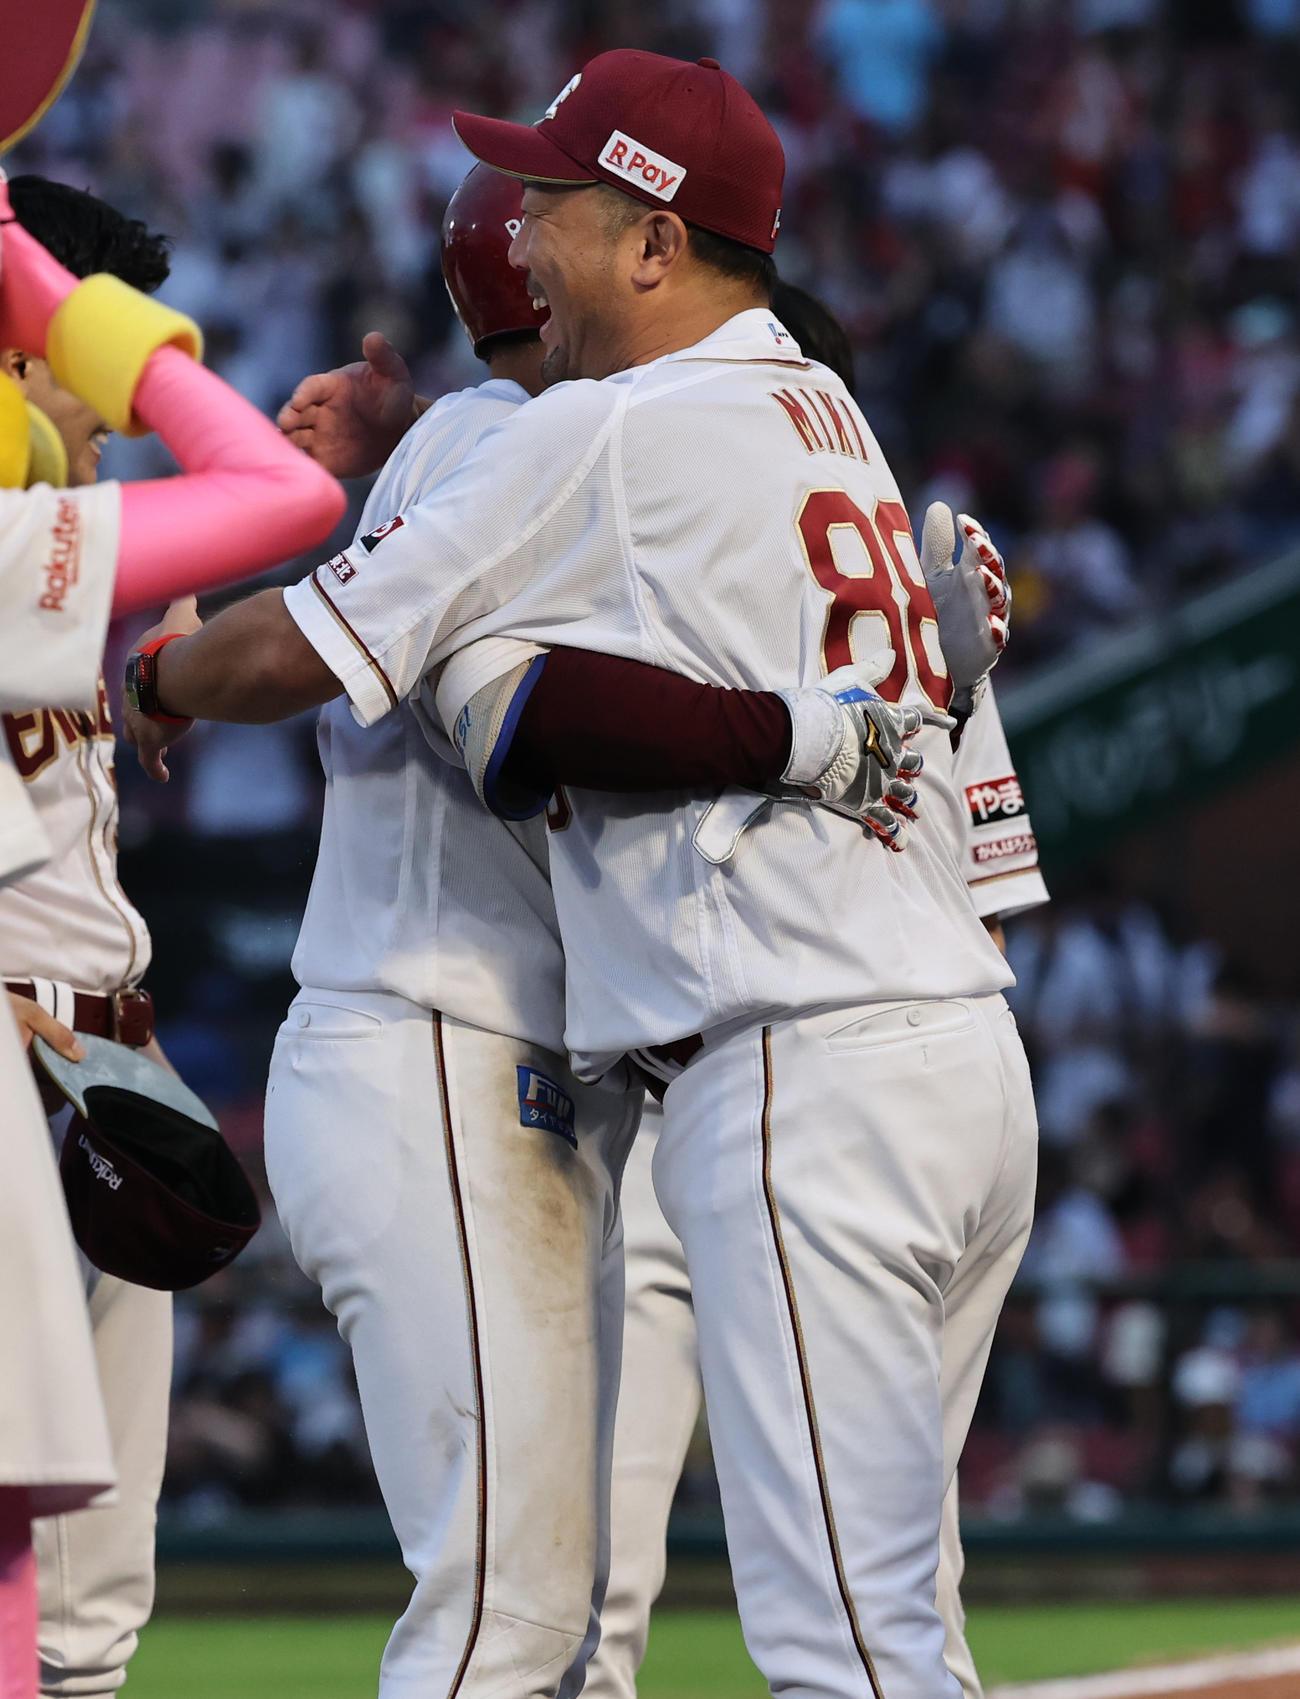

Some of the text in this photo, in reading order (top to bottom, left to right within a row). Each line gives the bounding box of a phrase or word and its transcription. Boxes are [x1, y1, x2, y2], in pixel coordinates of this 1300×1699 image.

[606, 140, 677, 192] R Pay
[769, 388, 870, 464] MIKI
[793, 486, 956, 715] 88
[970, 779, 1025, 821] やま
